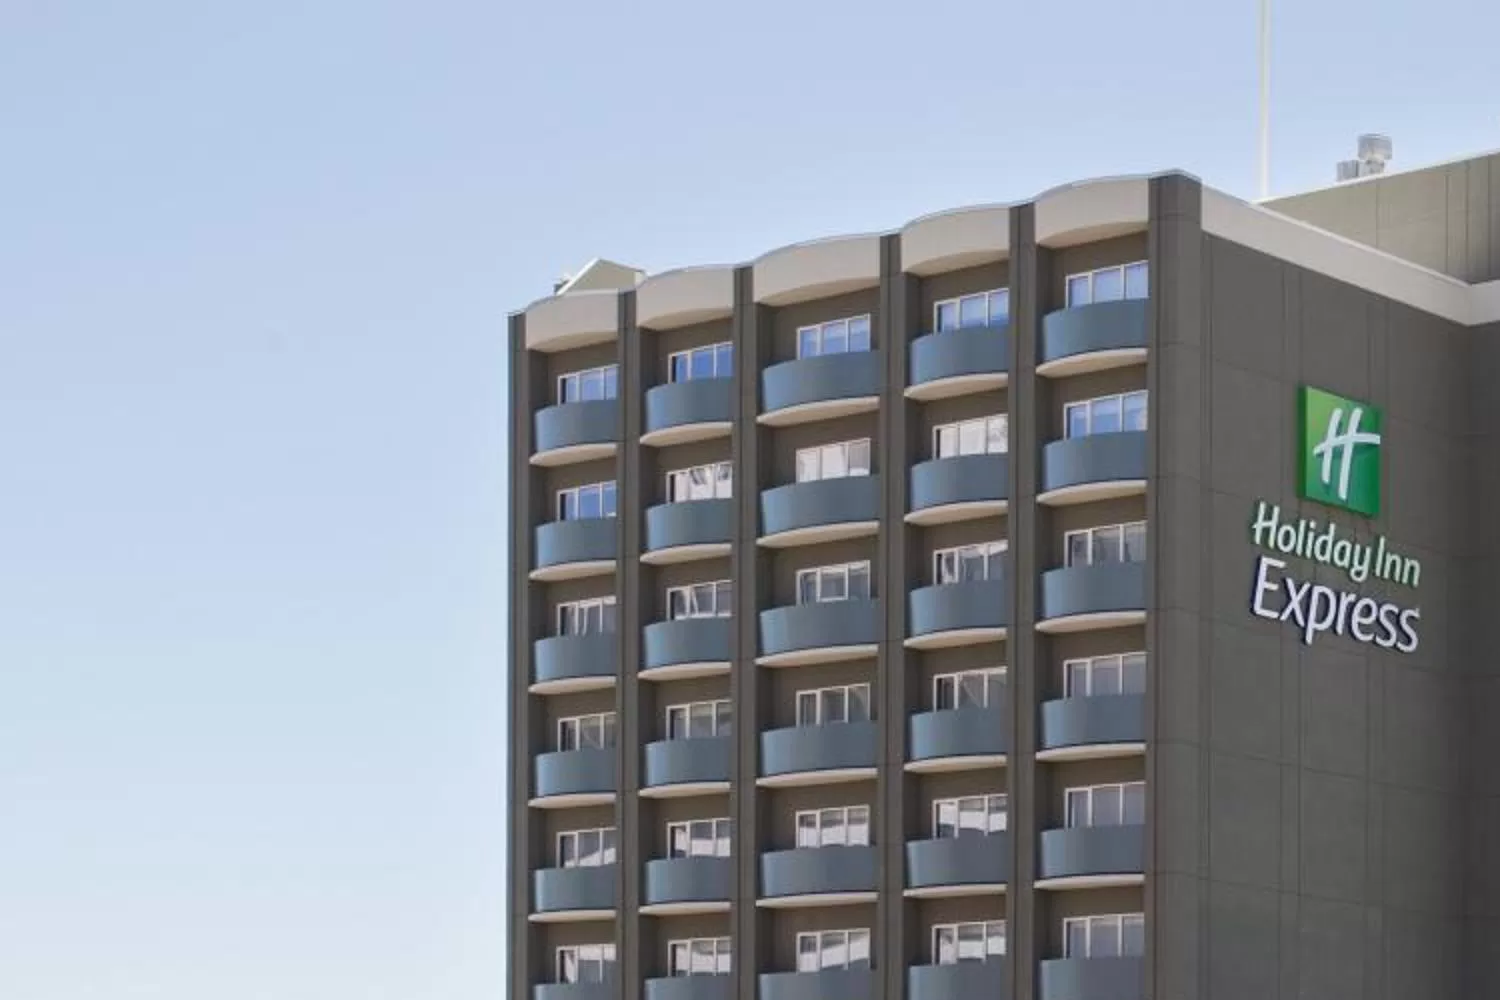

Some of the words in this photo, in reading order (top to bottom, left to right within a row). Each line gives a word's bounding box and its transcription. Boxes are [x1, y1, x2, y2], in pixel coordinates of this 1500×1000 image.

[1252, 500, 1372, 583] Holiday
[1375, 535, 1421, 588] Inn
[1252, 554, 1421, 653] Express
